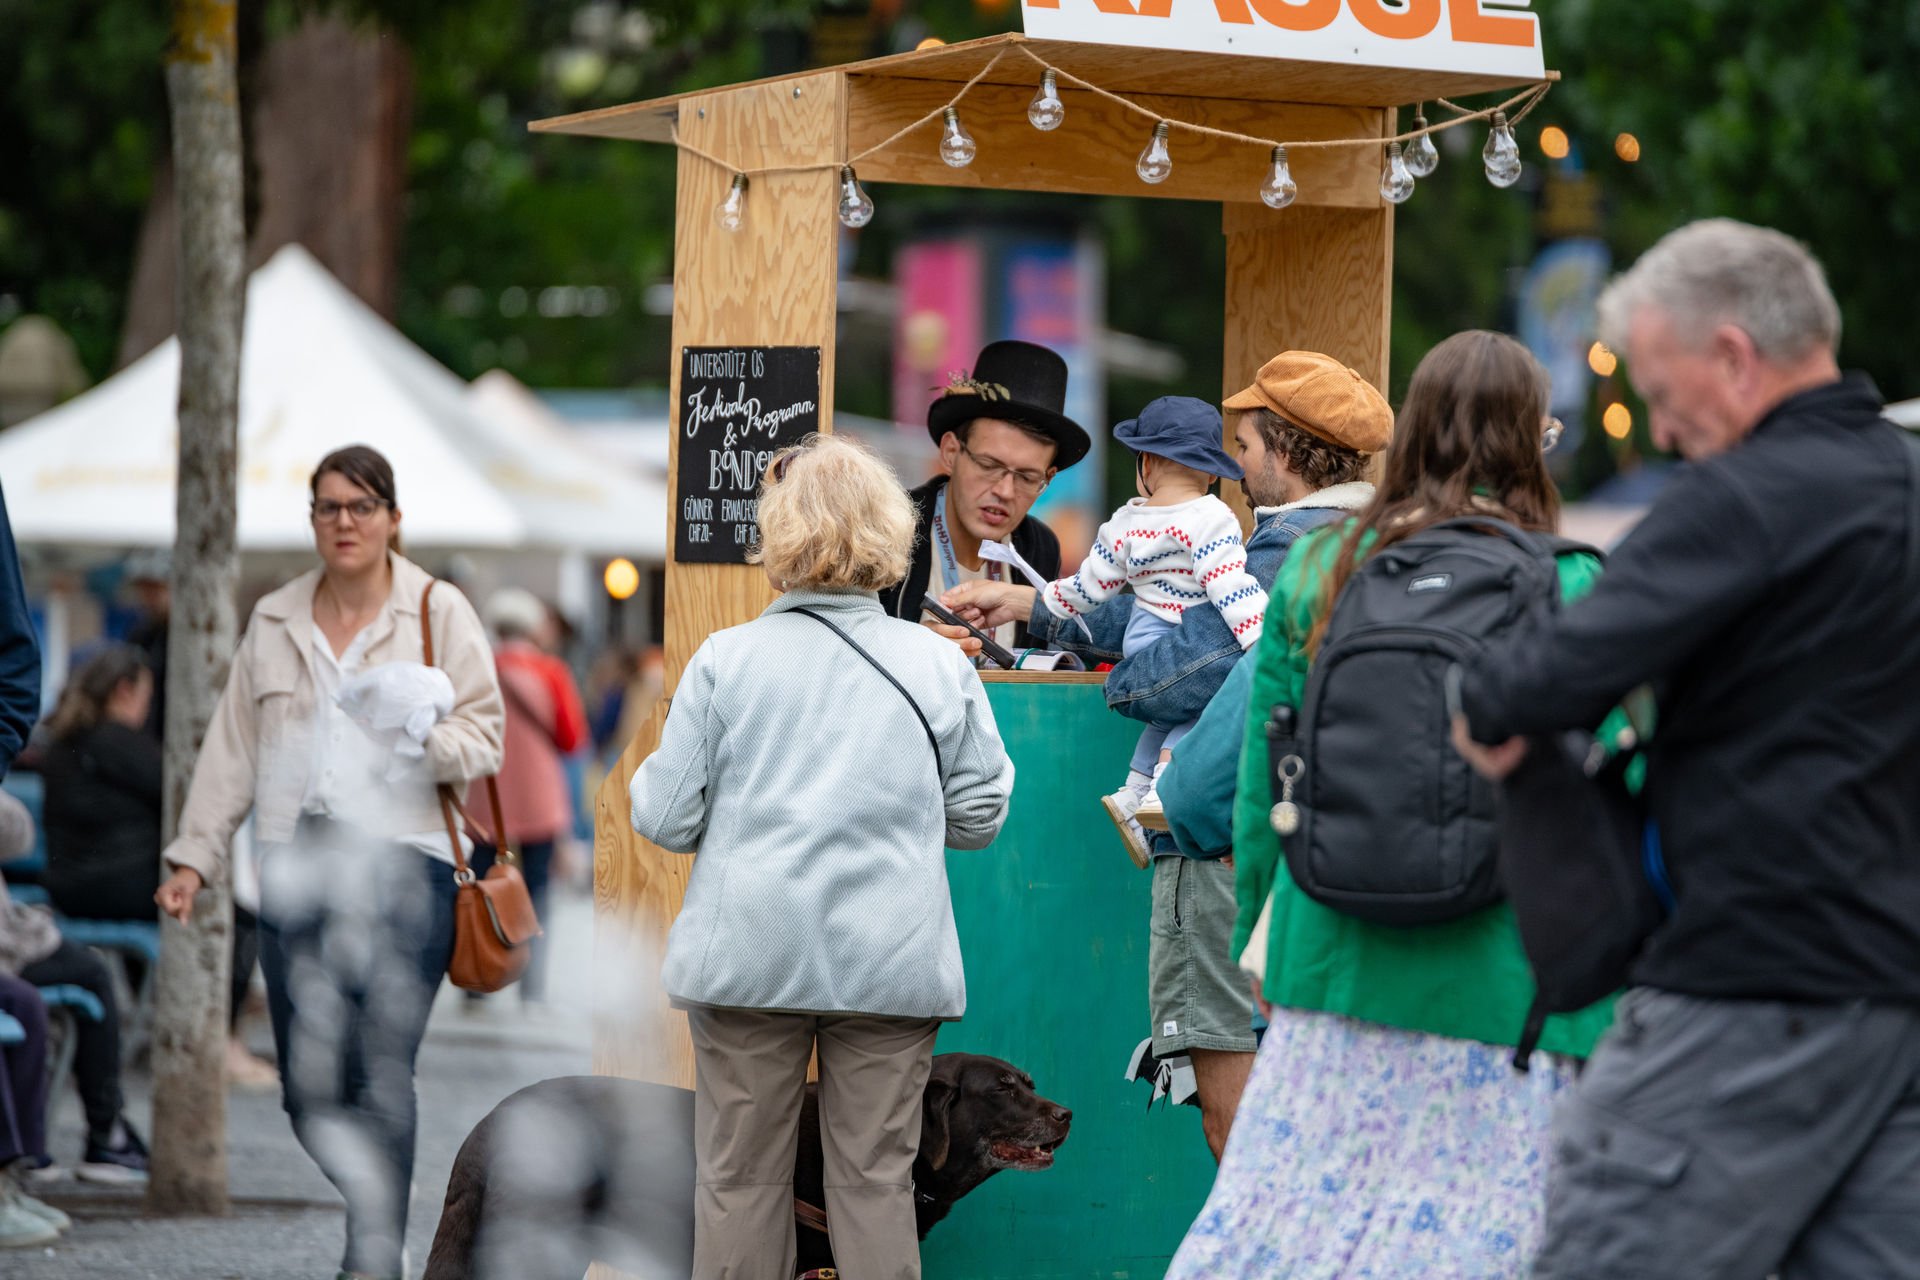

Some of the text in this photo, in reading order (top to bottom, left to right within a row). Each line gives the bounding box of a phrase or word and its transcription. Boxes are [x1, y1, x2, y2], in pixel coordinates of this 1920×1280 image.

[686, 381, 815, 438] Festival Programm
[723, 422, 738, 447] &
[684, 494, 714, 521] GÖNNER
[721, 498, 758, 522] ERWACHSE
[688, 523, 701, 542] CHF
[734, 523, 748, 544] CHF
